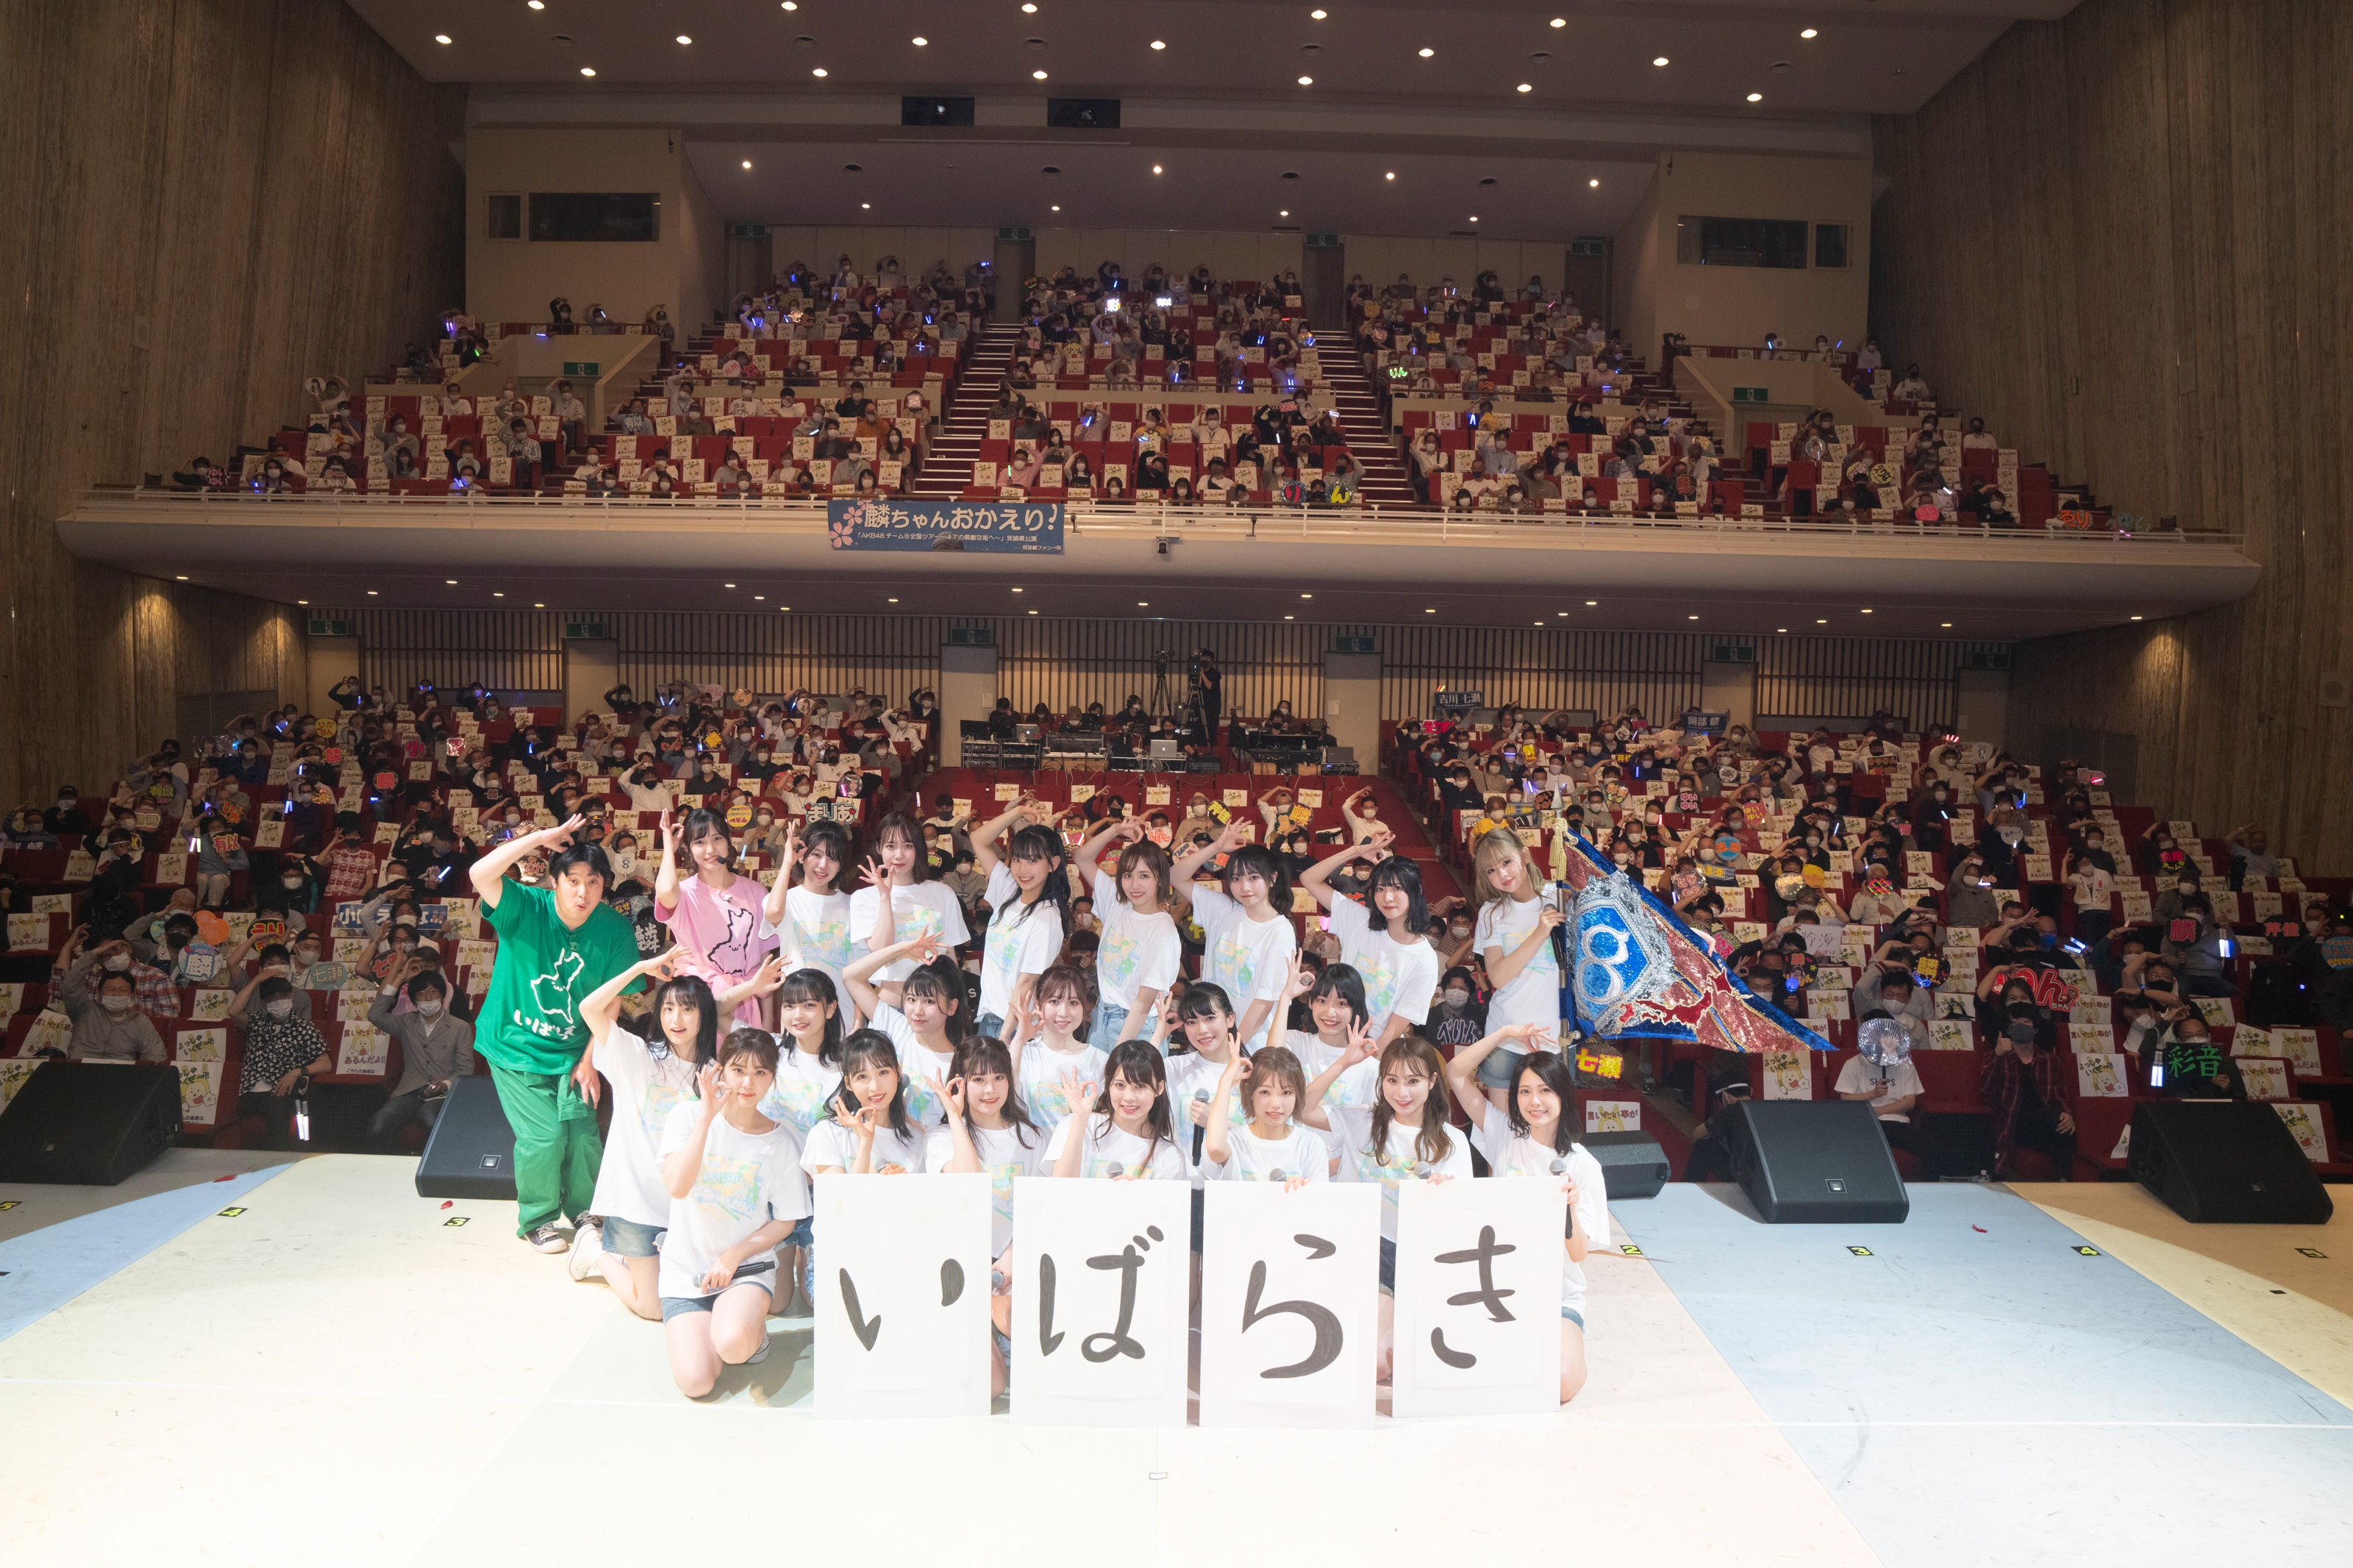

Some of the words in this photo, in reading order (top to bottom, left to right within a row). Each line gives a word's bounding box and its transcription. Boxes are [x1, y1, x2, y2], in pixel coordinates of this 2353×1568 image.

[1285, 484, 1301, 499] り
[1331, 484, 1350, 504] ん
[1438, 694, 1458, 704] 吉川
[1462, 692, 1481, 704] 七瀬
[1680, 793, 1698, 801] ゆい
[1680, 802, 1698, 810] ゆい
[807, 806, 854, 823] まりあ
[213, 833, 240, 853] 有以
[622, 859, 629, 870] 8
[2170, 918, 2196, 942] 麟
[2264, 922, 2299, 937] 芹佳
[185, 953, 214, 978] 麟
[1579, 924, 1630, 1003] 8
[312, 964, 344, 983] 七瀬
[2051, 1002, 2070, 1010] ちゃん
[1576, 1048, 1623, 1079] 七瀬
[2167, 1045, 2223, 1078] 彩音
[1869, 1078, 1896, 1086] SHPS
[1587, 1109, 1638, 1121] 言いたい事が
[221, 1207, 243, 1217] 4
[447, 1217, 467, 1227] 3
[1621, 1245, 1642, 1255] 2
[1851, 1247, 1871, 1256] 3
[2080, 1246, 2099, 1256] 4
[840, 1259, 964, 1350] い
[1040, 1226, 1163, 1362] ば
[1243, 1235, 1343, 1378] ら
[1432, 1225, 1515, 1368] き
